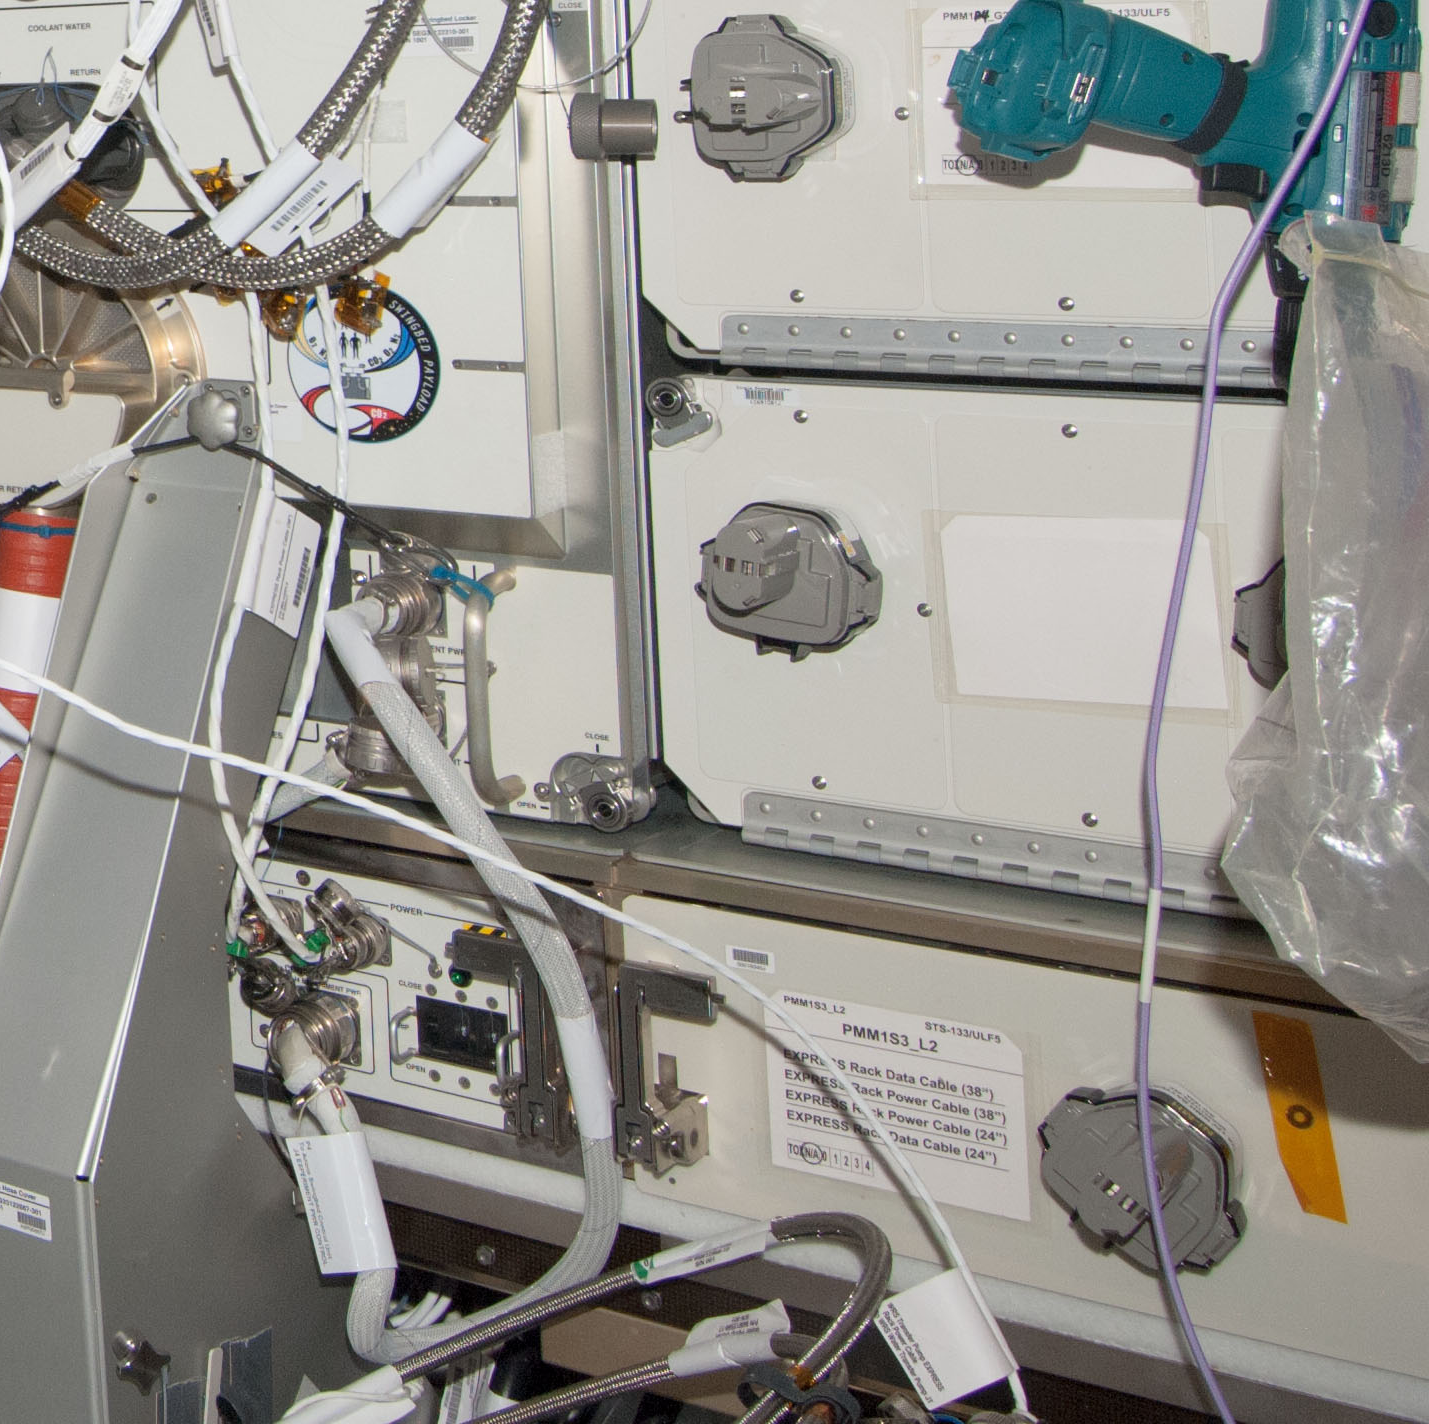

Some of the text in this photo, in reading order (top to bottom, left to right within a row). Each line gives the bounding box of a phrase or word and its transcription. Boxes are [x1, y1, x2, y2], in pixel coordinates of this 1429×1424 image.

[558, 1, 582, 9] CLOSE
[27, 22, 91, 32] COOLANT WATER
[70, 68, 101, 76] RETURN
[1381, 134, 1392, 178] 6213D
[389, 300, 431, 414] SWINGBED PAYLOAD
[585, 732, 609, 742] CLOSE
[516, 801, 537, 809] OPEN
[390, 904, 423, 917] POWER
[399, 980, 422, 989] CLOSE
[783, 995, 846, 1014] PMM1S3_L2
[842, 1023, 939, 1053] PMM1S3_L2
[924, 1021, 1002, 1044] STS-133/ULF5
[406, 1064, 426, 1073] OPEN
[849, 1061, 882, 1077] Rack
[885, 1069, 916, 1084] Data
[919, 1076, 958, 1093] Cable
[886, 1089, 927, 1107] Power
[931, 1098, 970, 1115] Cable
[785, 1089, 848, 1111] EXPRESS
[887, 1110, 928, 1128] Power
[932, 1119, 971, 1137] Cable
[786, 1109, 849, 1132] EXPRESS
[853, 1123, 882, 1138] Rac
[923, 1138, 961, 1155] Cable
[804, 1146, 820, 1159] N/A
[19, 1189, 37, 1201] Cover
[883, 1311, 918, 1364] Rack Power Cable
[887, 1302, 945, 1392] WRS Transfer Pump EXPRESS
[878, 1318, 927, 1396] WRS Water Transfer Pump
